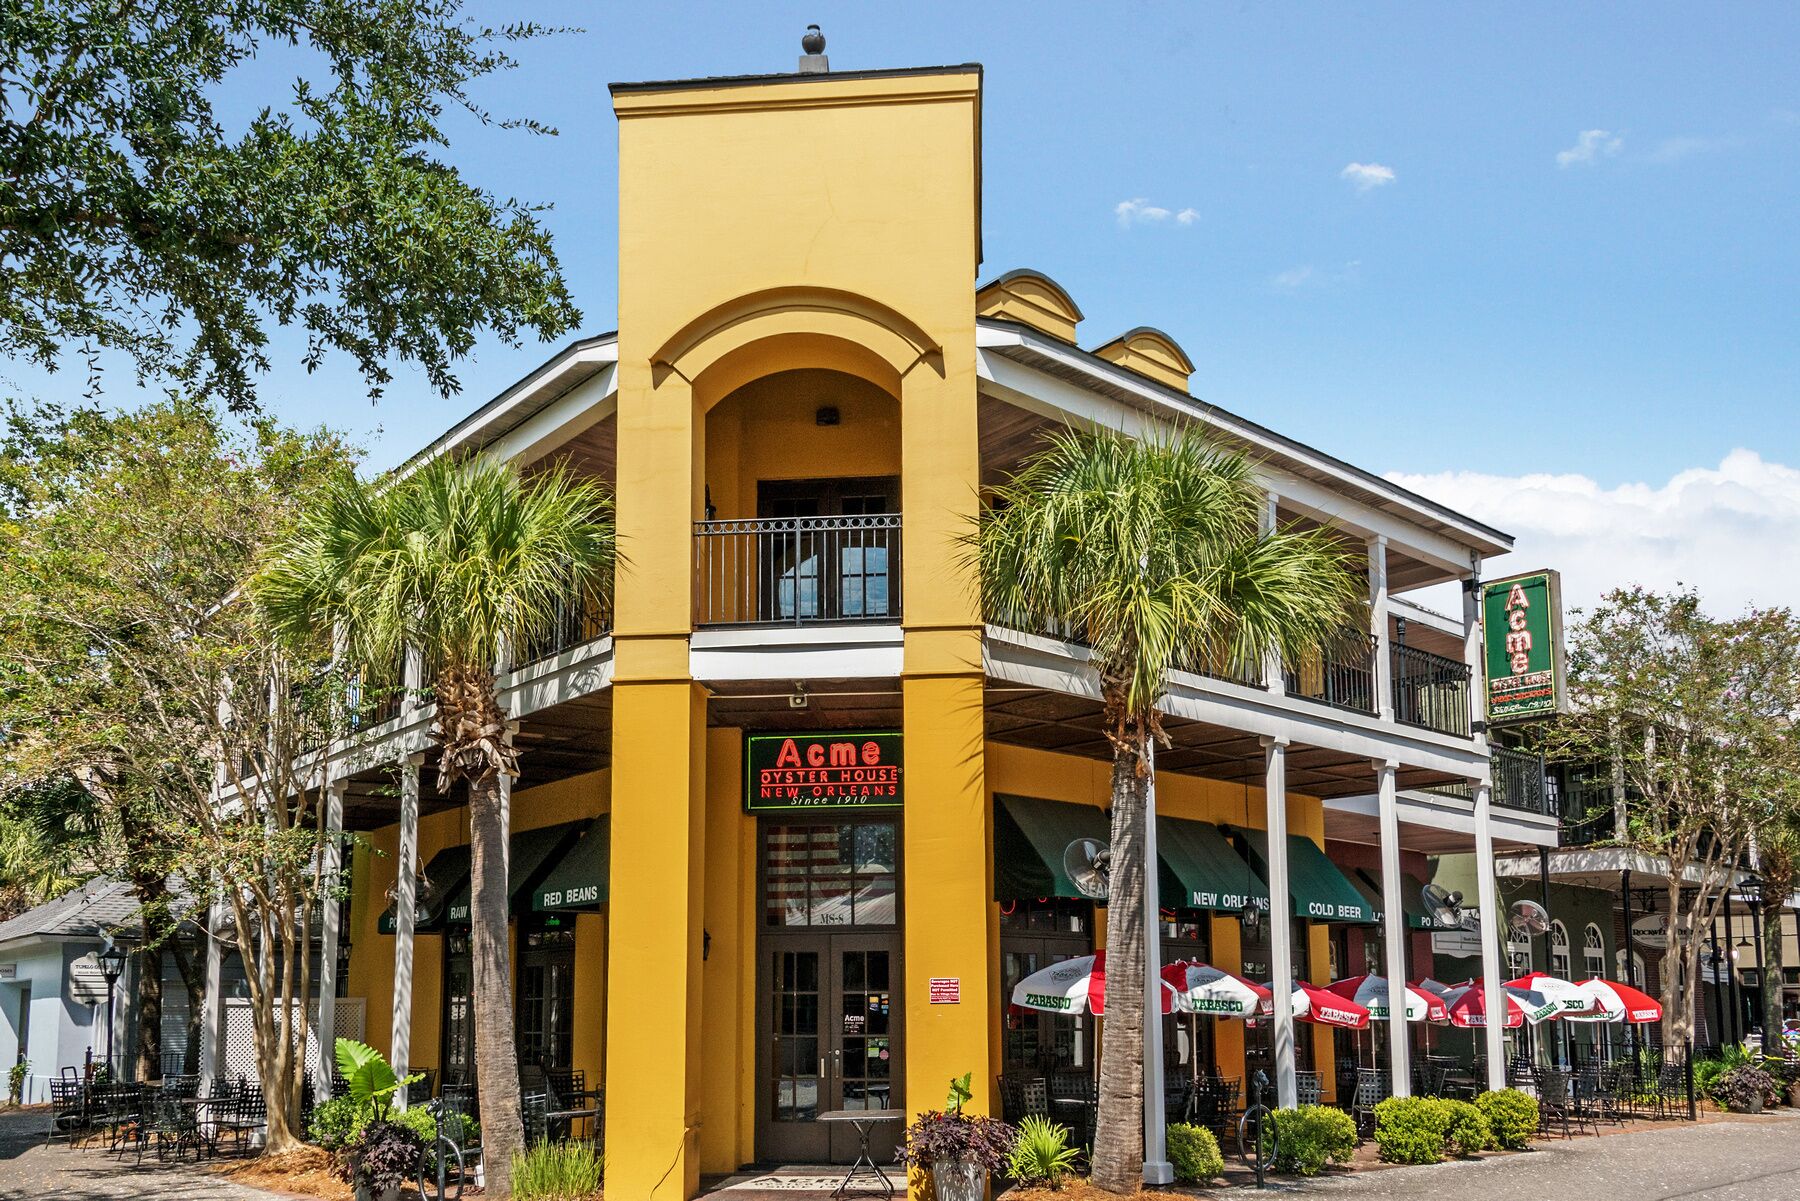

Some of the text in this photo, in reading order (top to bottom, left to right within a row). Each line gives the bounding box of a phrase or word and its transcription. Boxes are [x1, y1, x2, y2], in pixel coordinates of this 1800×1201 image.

[1505, 583, 1532, 675] Acme
[776, 738, 881, 767] Acme
[760, 769, 898, 784] OYSTER HOUSE
[760, 785, 896, 798] NEW ORLEANS
[790, 795, 868, 805] Since 1910
[543, 886, 598, 907] RED BEANS
[1193, 891, 1270, 911] NEW ORLENS
[450, 905, 468, 919] RAW
[1309, 902, 1334, 916] COLD
[1338, 905, 1361, 919] BEER
[1421, 916, 1431, 927] PO
[1026, 994, 1072, 1010] TABASCO
[1192, 998, 1243, 1012] TABASCO
[1319, 1006, 1361, 1025] TABASCO
